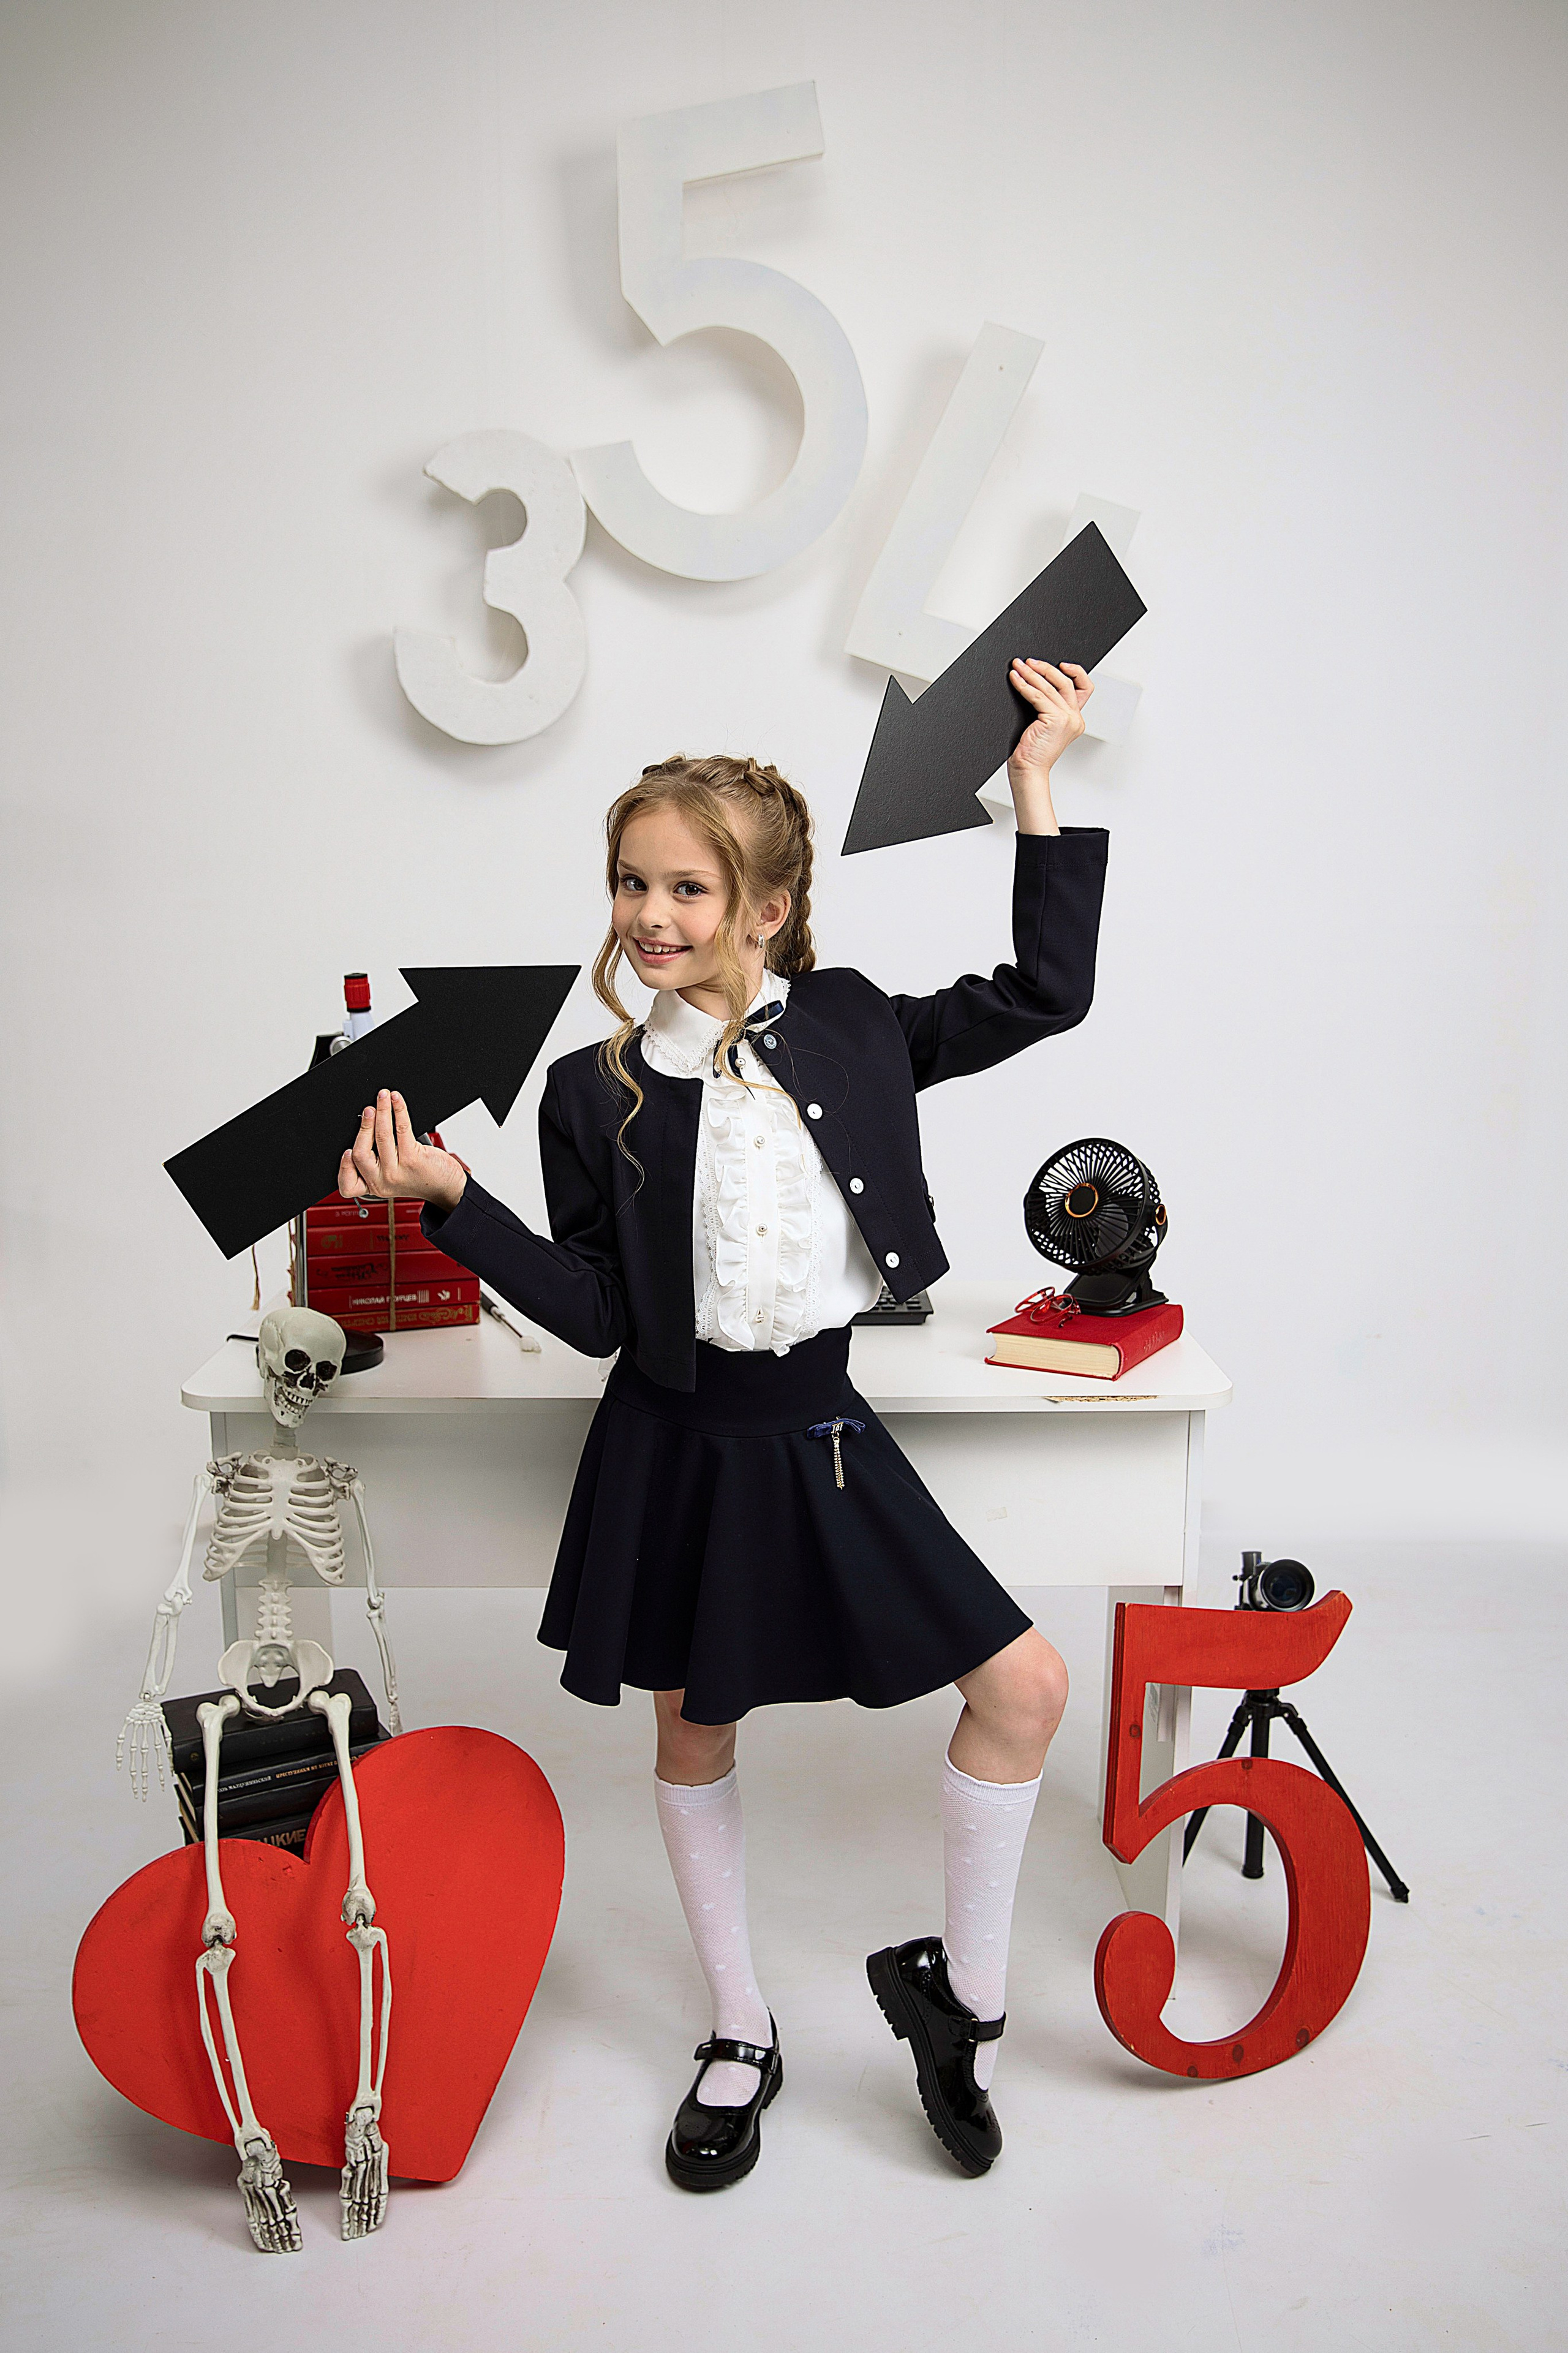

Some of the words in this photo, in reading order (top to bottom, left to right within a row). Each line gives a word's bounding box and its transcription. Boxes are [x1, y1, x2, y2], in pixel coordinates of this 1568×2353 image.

[570, 80, 869, 583] 5
[393, 429, 587, 745] 3
[1093, 1590, 1370, 2079] 5
